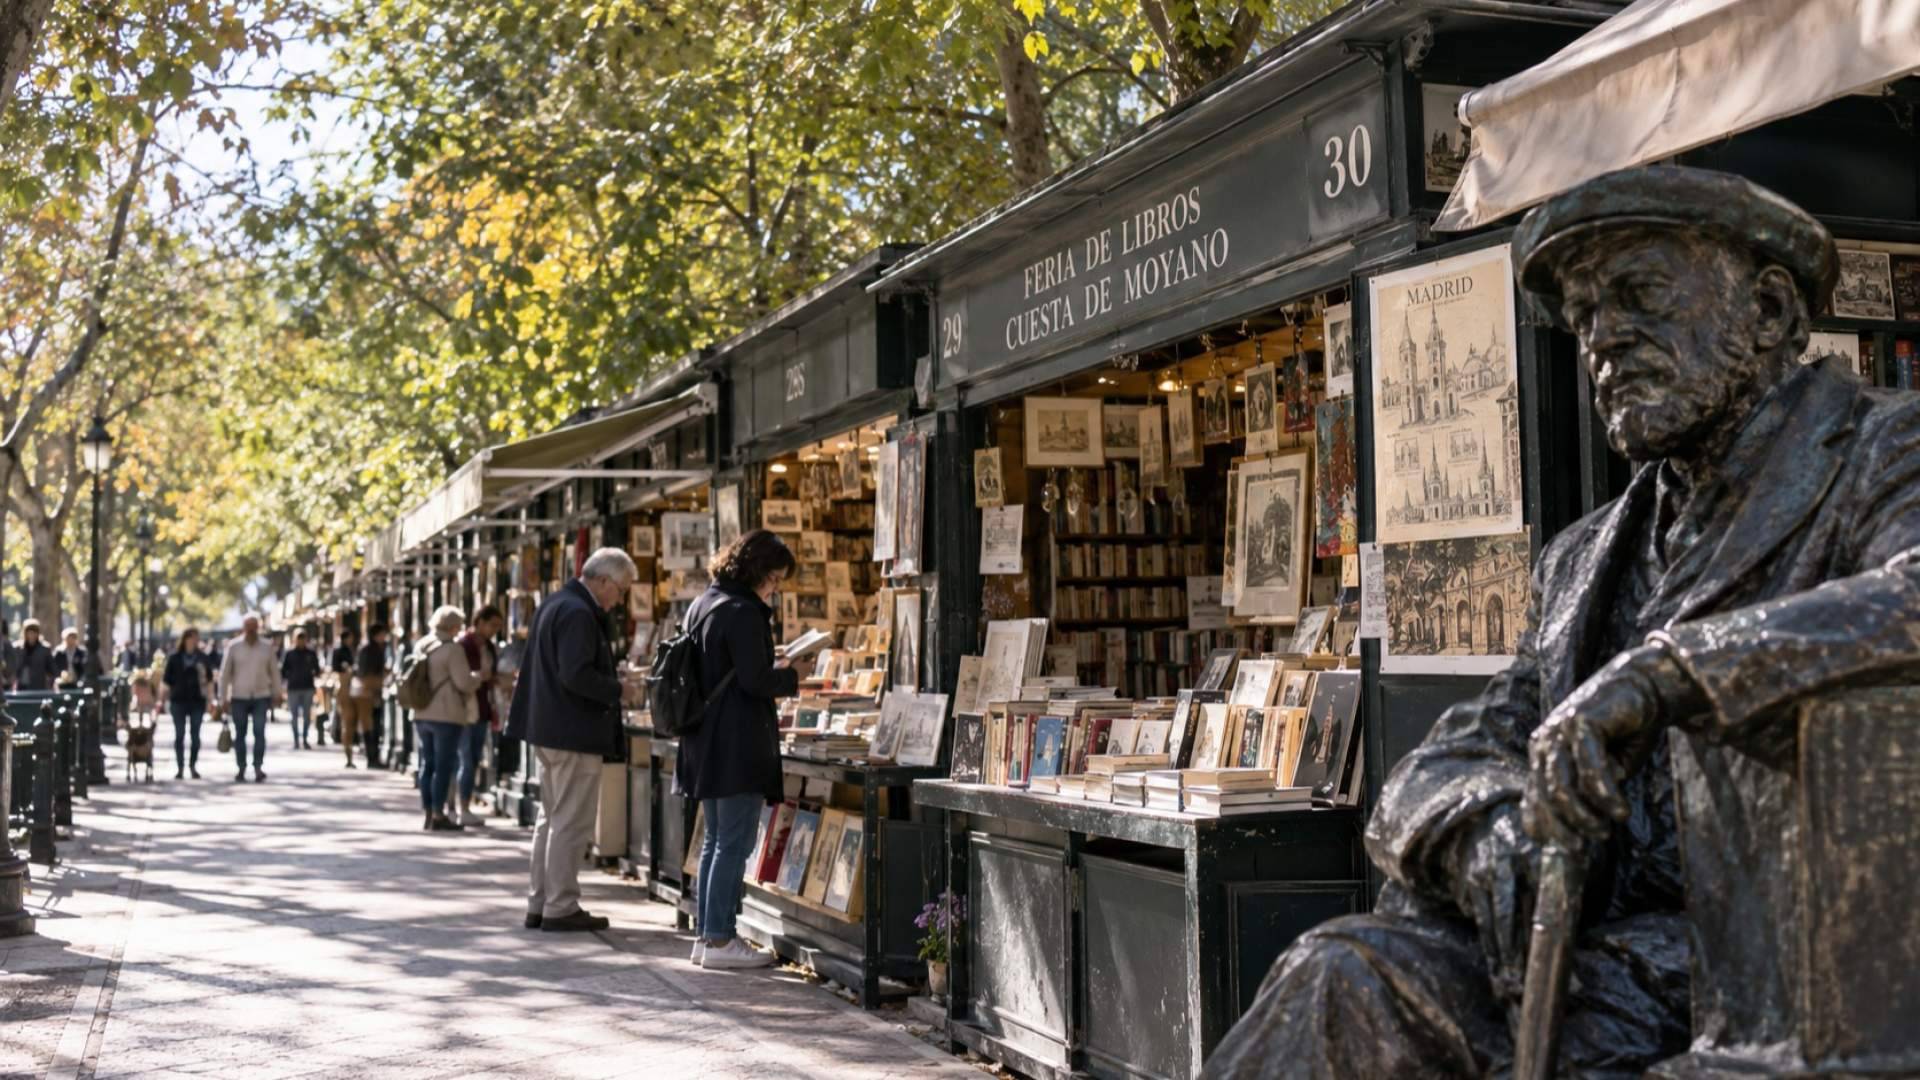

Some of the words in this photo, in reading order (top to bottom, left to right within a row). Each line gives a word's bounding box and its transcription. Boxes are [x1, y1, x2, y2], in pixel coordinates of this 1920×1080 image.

[1324, 124, 1371, 198] 30
[1023, 247, 1076, 299] FERIA
[1085, 228, 1112, 273] DE
[1121, 186, 1201, 255] LIBROS
[1005, 294, 1075, 350] CUESTA
[1084, 276, 1112, 320] DE
[1124, 227, 1229, 304] MOYANO
[1407, 276, 1473, 306] MADRID
[942, 312, 962, 359] 29
